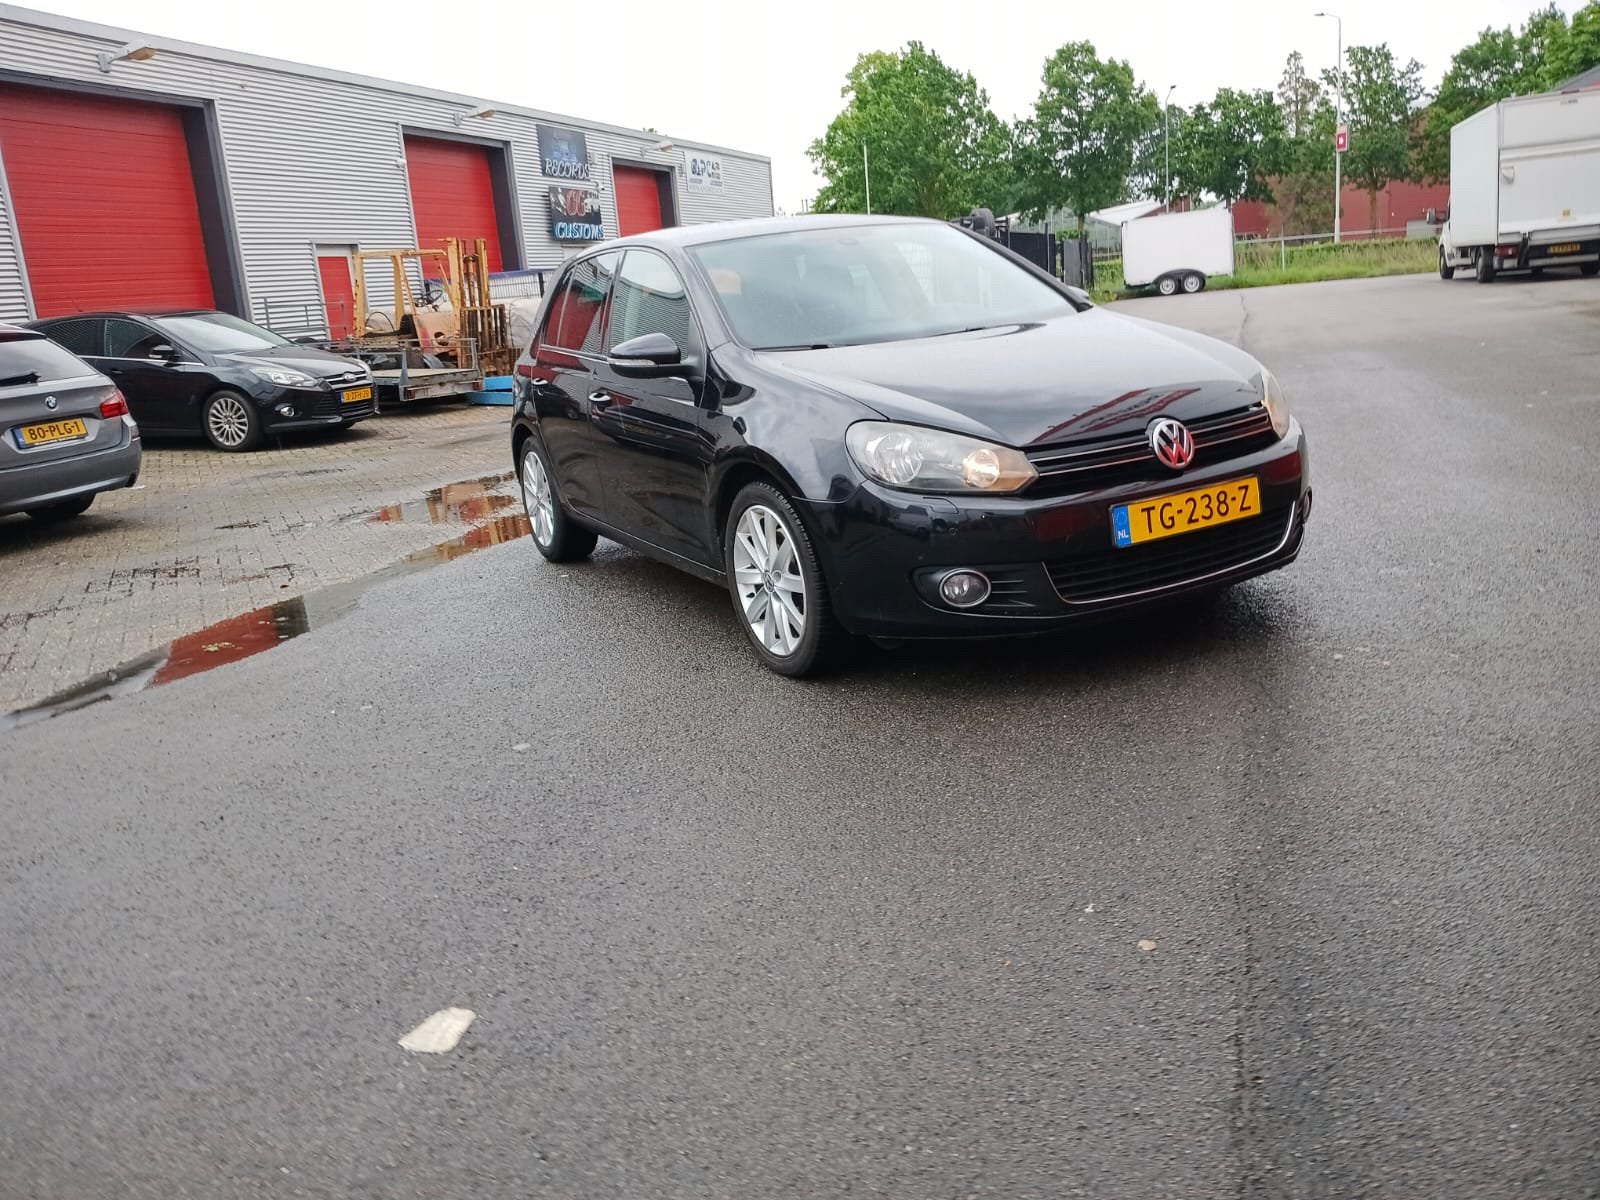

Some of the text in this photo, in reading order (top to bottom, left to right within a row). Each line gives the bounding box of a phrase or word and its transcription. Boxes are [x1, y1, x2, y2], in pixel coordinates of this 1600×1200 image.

[545, 158, 591, 180] RECORDS
[555, 222, 605, 240] CUSTOMS
[28, 421, 81, 440] 80-PLG-1
[1141, 484, 1252, 534] TG-238-Z
[1117, 530, 1129, 539] NL
